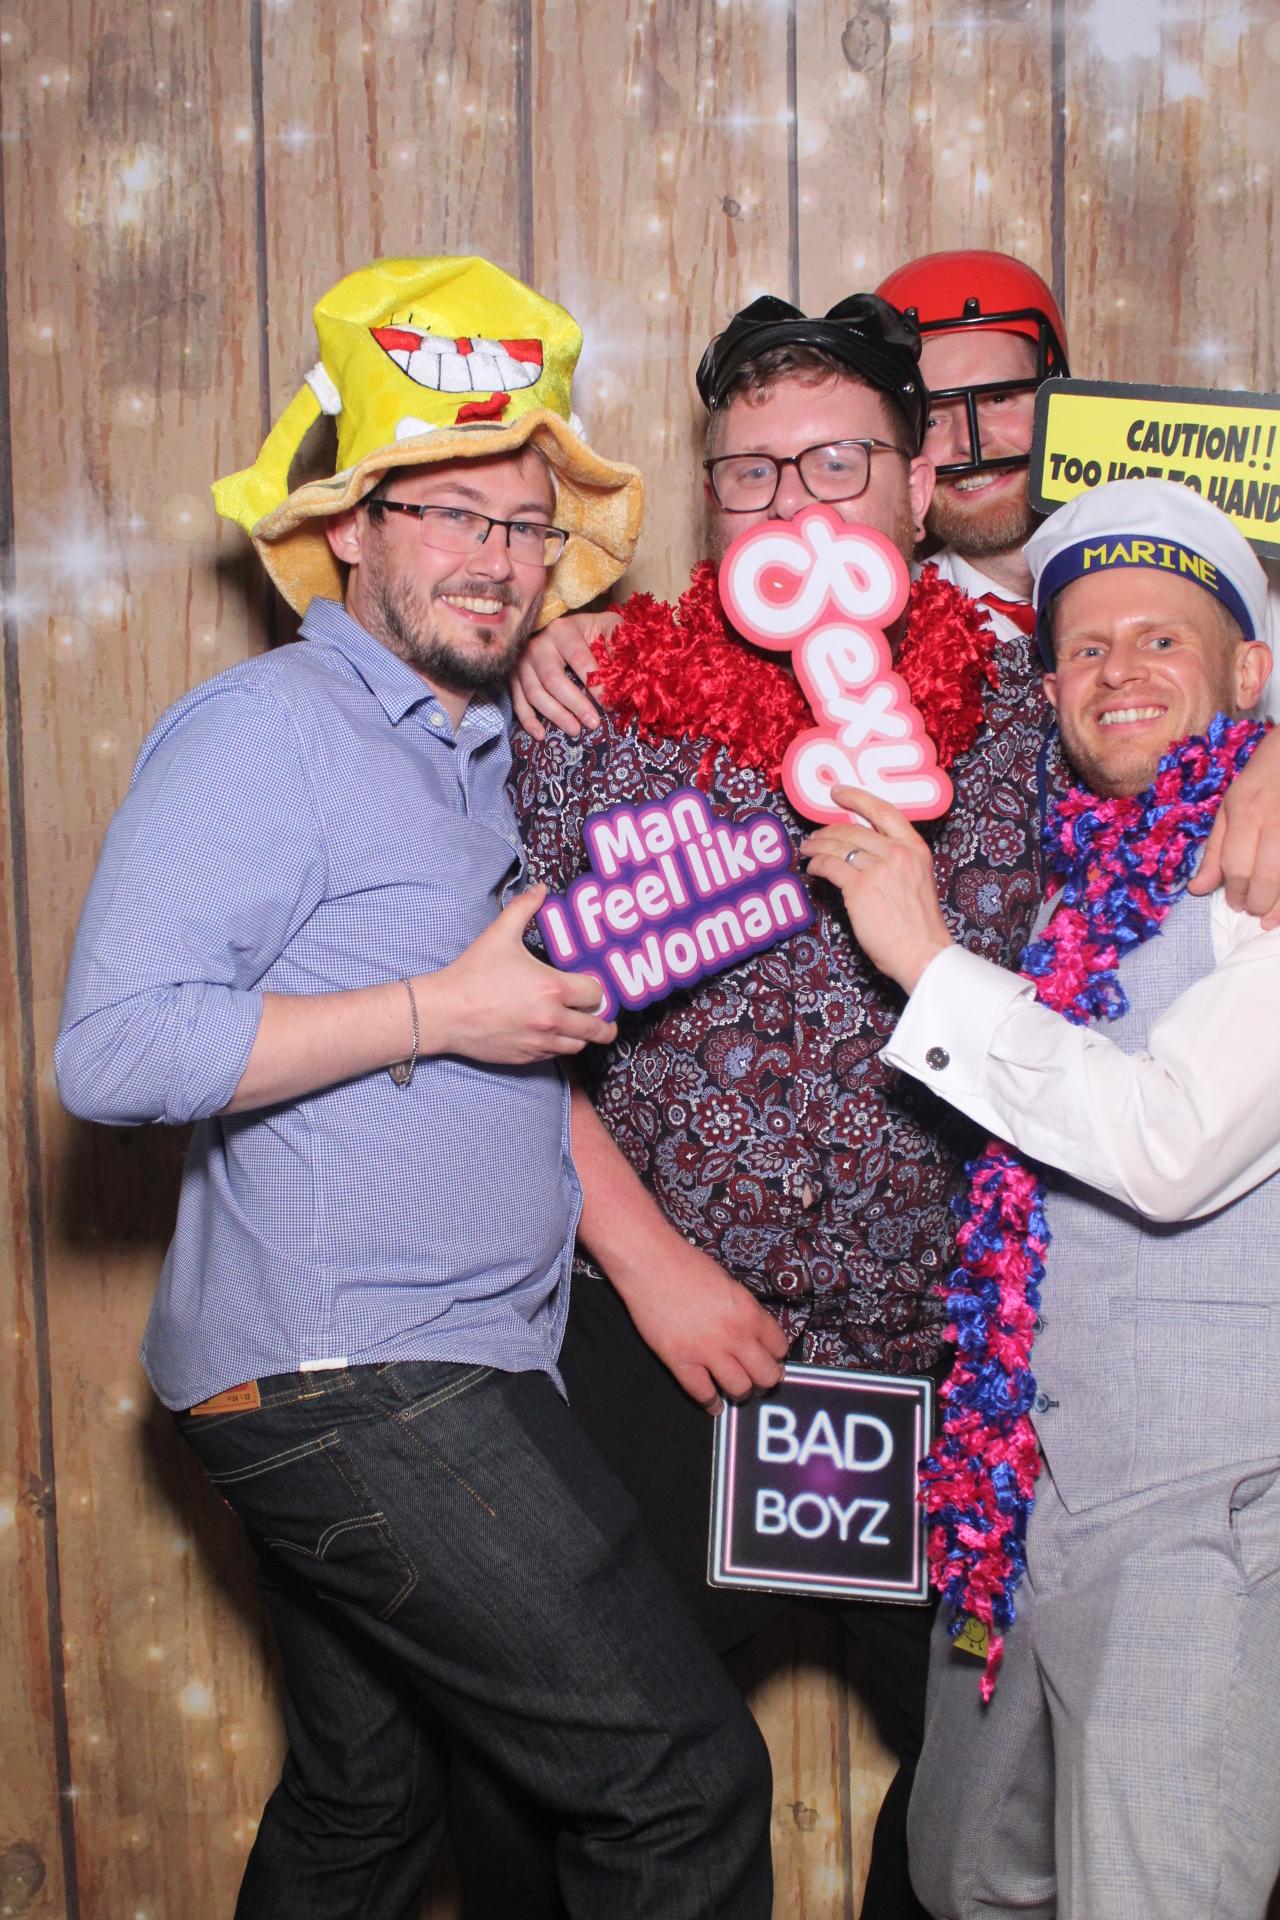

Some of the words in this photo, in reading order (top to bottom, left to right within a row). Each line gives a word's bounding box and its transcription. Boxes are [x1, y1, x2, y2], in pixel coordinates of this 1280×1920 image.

[1050, 453, 1102, 487] TOO
[1127, 419, 1277, 471] CAUTION!!
[1083, 540, 1219, 590] MARINE
[734, 521, 936, 832] Sexy
[594, 798, 708, 874] Man
[546, 907, 573, 956] I
[577, 854, 686, 943] feel
[686, 824, 782, 893] like
[757, 1404, 893, 1472] BAD
[755, 1489, 890, 1546] BOYZ
